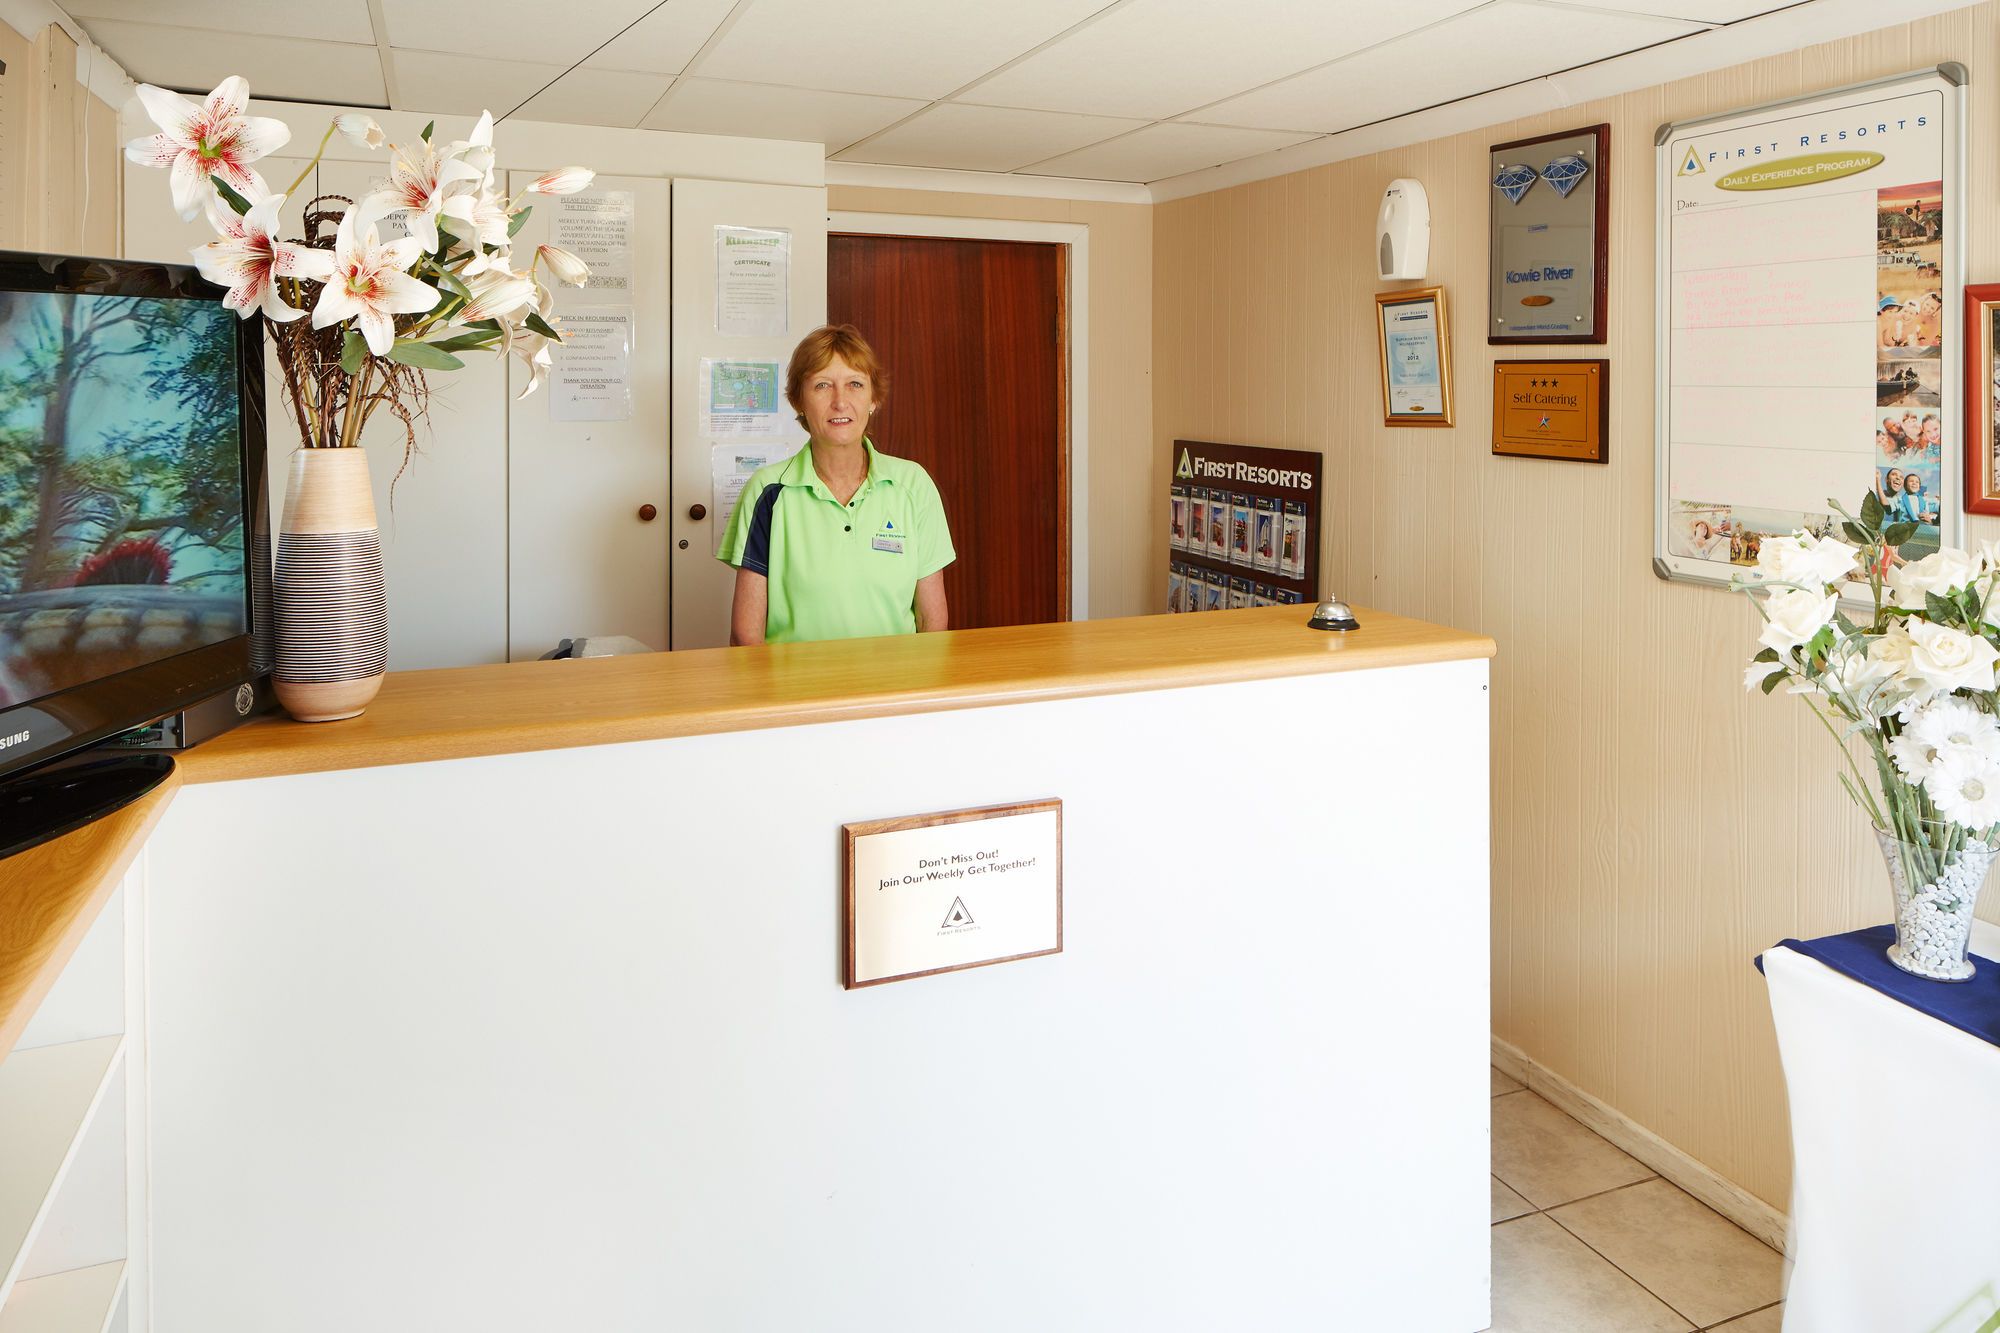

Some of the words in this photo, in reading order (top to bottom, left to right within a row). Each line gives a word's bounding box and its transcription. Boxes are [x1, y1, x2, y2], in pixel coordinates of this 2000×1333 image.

[1709, 142, 1779, 163] FIRST
[1800, 116, 1927, 147] RESORTS
[1723, 175, 1751, 187] DAILY
[1751, 166, 1815, 183] EXPERIENCE
[1815, 157, 1872, 173] PROGRAM
[1677, 199, 1699, 211] Date:
[734, 259, 771, 267] CERTIFICATE
[1506, 269, 1540, 284] Kowie
[1543, 267, 1574, 281] River
[1513, 393, 1532, 404] Self
[1534, 393, 1577, 407] Catering
[1194, 457, 1235, 479] FIRST
[1236, 461, 1312, 490] RESORTS
[919, 857, 948, 869] Don't
[952, 854, 973, 864] Miss
[976, 849, 999, 860] Out!
[878, 878, 900, 891] Join
[903, 875, 925, 885] Our
[926, 869, 964, 881] Weekly
[968, 865, 988, 875] Get
[988, 857, 1036, 873] Together!
